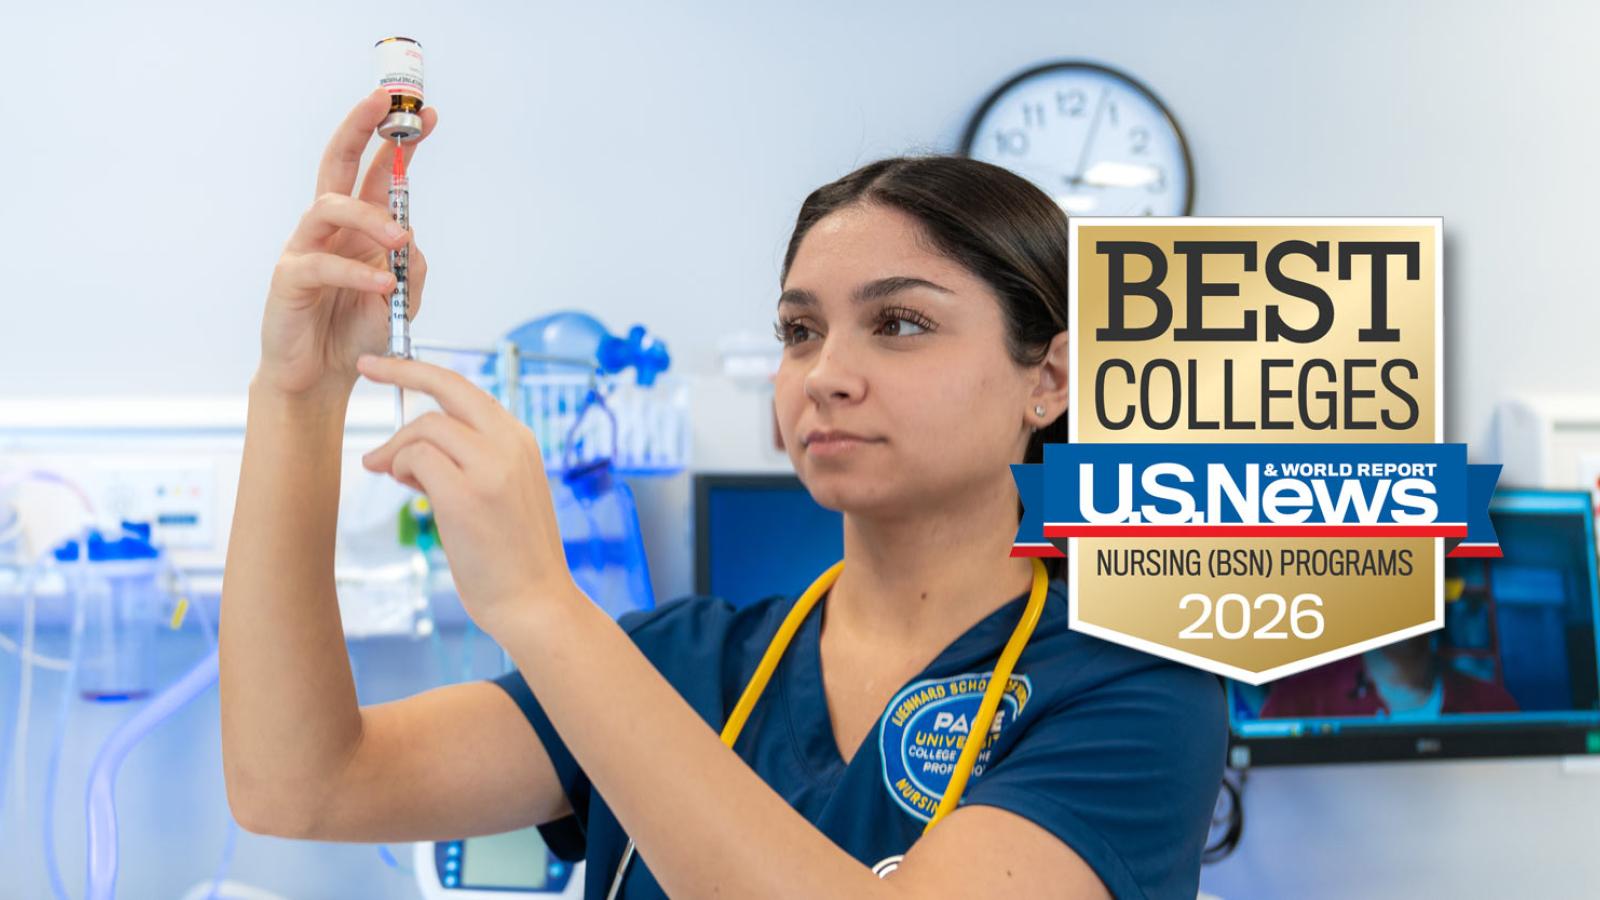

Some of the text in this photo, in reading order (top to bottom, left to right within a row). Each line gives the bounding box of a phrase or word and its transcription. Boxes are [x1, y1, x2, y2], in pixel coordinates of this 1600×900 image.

[1022, 101, 1046, 128] 11
[1055, 88, 1087, 117] 12
[995, 129, 1029, 156] 10
[1130, 126, 1149, 154] 2
[892, 679, 989, 727] LIENHARD SCHO
[933, 710, 1005, 733] PAE
[909, 745, 956, 761] COLLEGE
